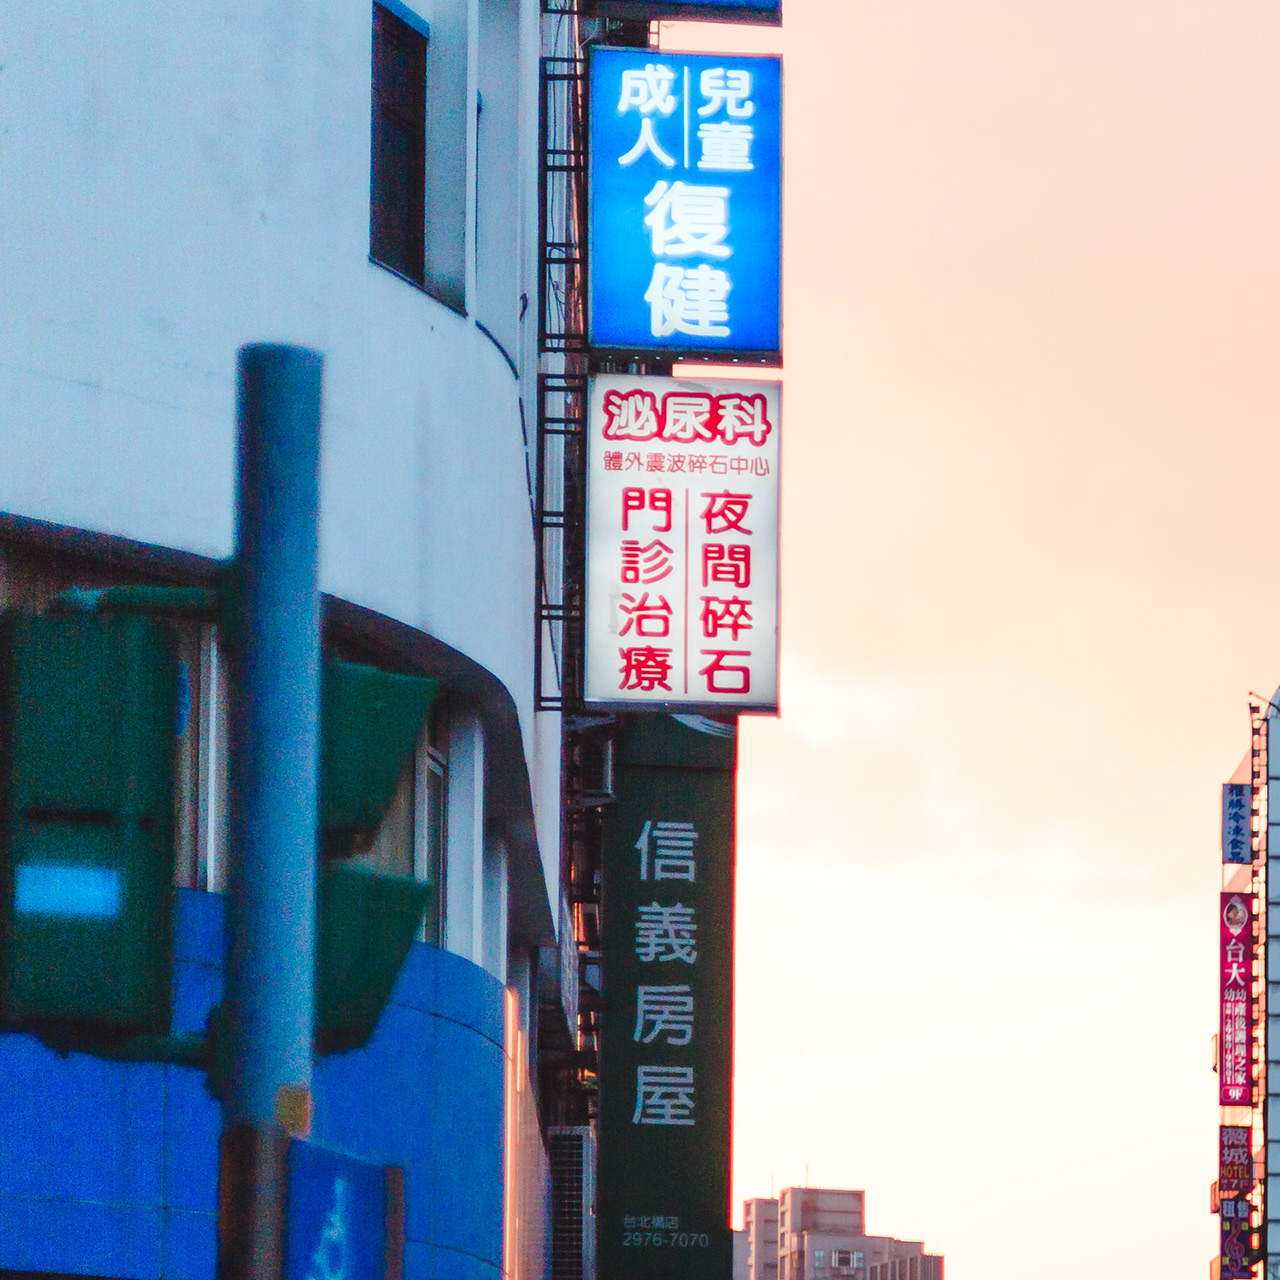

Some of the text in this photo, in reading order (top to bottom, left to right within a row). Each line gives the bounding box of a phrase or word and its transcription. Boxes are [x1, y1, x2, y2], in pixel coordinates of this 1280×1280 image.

[618, 65, 675, 168] 成人
[697, 67, 755, 171] 兒童
[644, 180, 732, 339] 復健
[603, 451, 770, 476] 體外震波碎石中心
[604, 391, 771, 443] 泌尿科
[618, 486, 673, 693] 門診治療
[699, 488, 753, 695] 夜間碎石
[632, 820, 699, 1126] 信義房屋
[1226, 938, 1246, 987] 台大
[1221, 1165, 1249, 1178] HOTEL
[622, 1231, 709, 1248] 2976-7070
